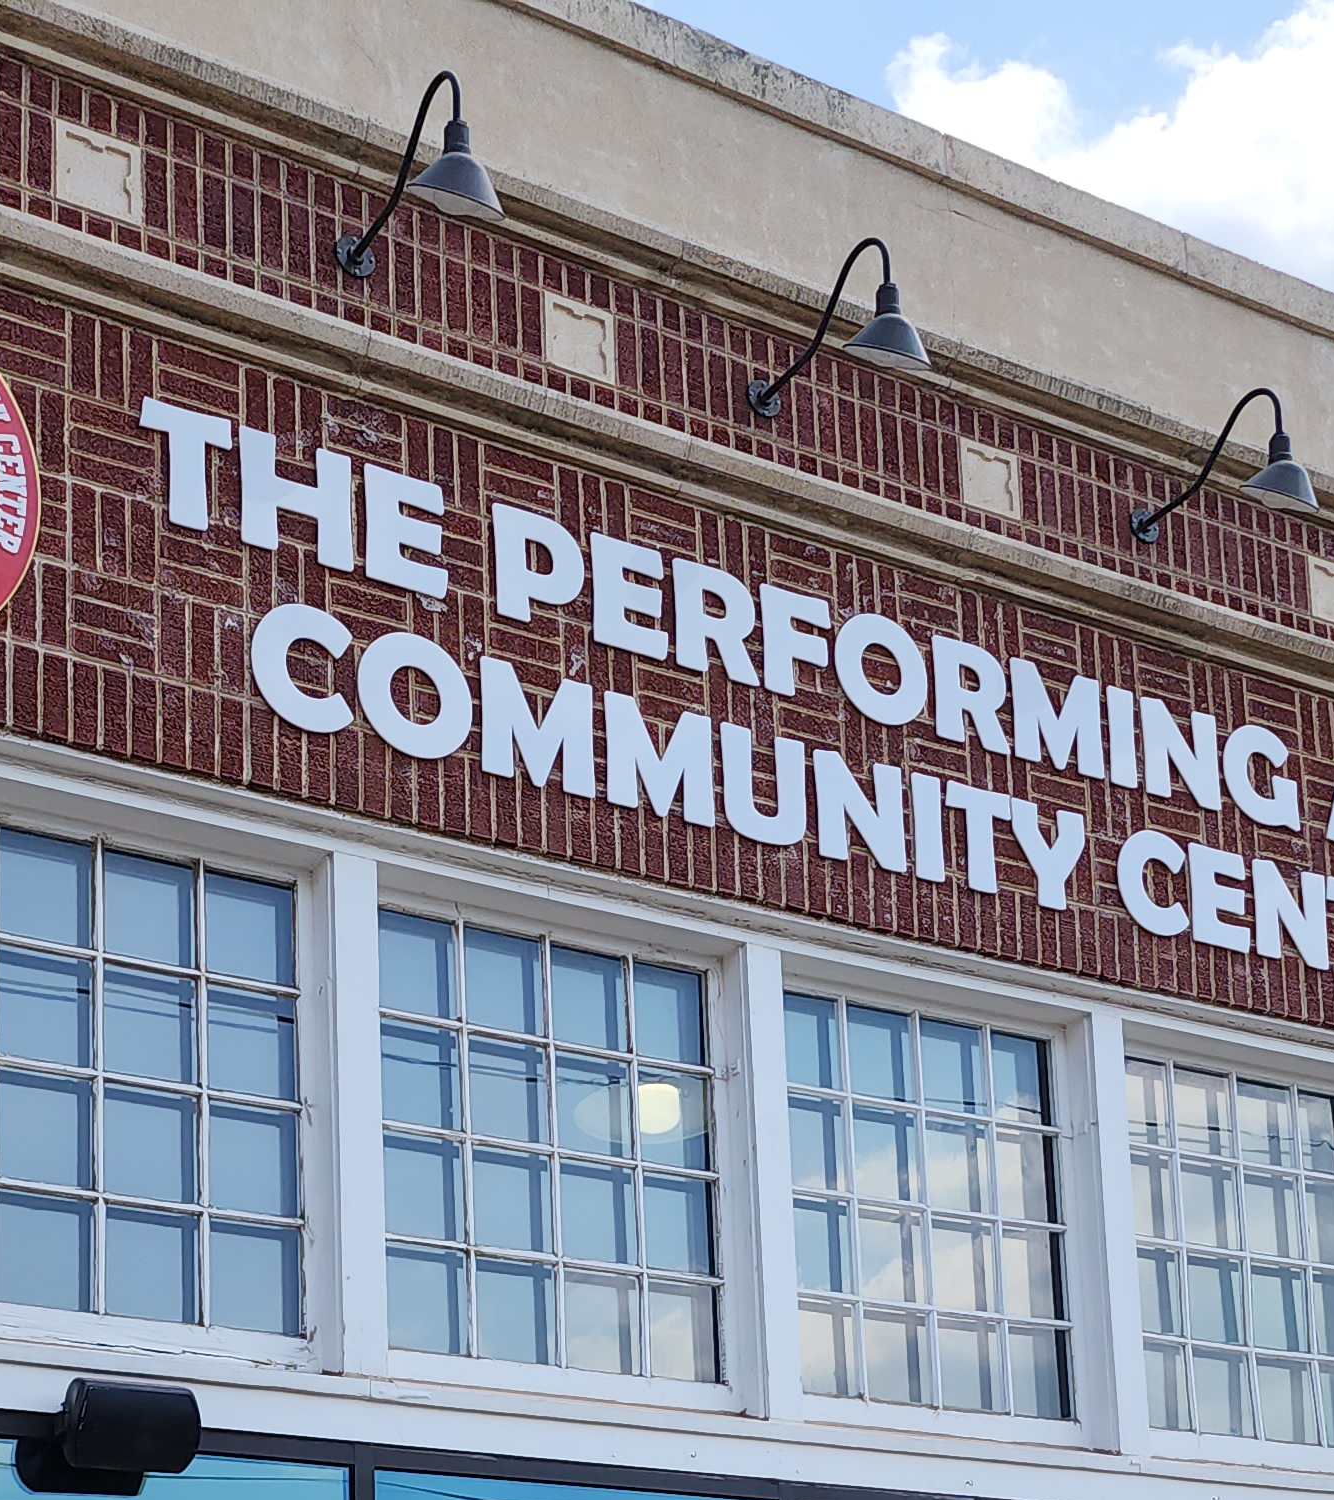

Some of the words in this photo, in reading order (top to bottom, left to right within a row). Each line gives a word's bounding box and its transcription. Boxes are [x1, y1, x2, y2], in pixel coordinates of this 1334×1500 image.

[138, 395, 449, 600] THE
[491, 501, 1301, 832] PERFORMING
[250, 602, 1086, 911] COMMUNITY
